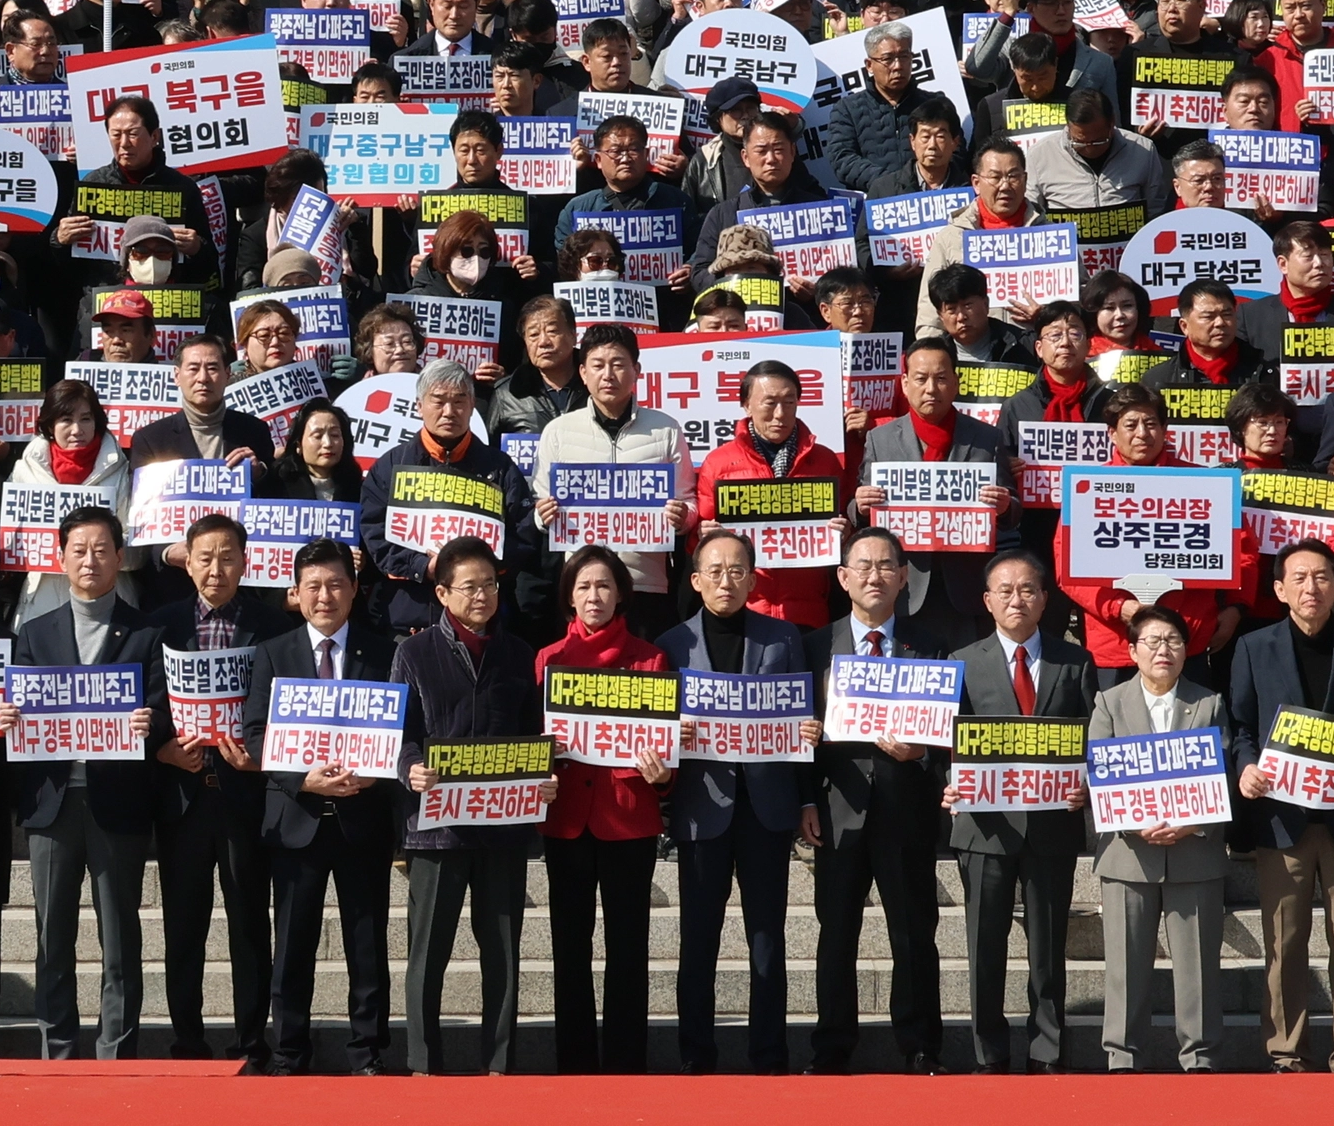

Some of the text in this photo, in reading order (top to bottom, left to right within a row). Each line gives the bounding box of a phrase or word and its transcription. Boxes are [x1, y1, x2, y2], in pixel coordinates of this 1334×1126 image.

[725, 30, 787, 53] 국민의힘
[164, 60, 195, 71] 국민의힘
[685, 54, 727, 79] 대구
[733, 56, 798, 86] 중남구
[166, 71, 266, 113] 북구을
[327, 112, 379, 125] 국민의힘
[308, 134, 451, 158] 대구중구남구
[968, 227, 1072, 263] 광주전남 다퍼주고
[1181, 232, 1247, 250] 국민의힘
[1141, 259, 1262, 286] 대구 달성군
[717, 351, 750, 361] 국민의힘
[1094, 482, 1135, 493] 국민의힘
[1094, 497, 1212, 520] 보수의심장
[1094, 522, 1210, 549] 상주문경
[1144, 553, 1223, 569] 당원협의회
[549, 672, 678, 712] 대구경북행정통합특별법
[685, 678, 806, 715] 광주전남 다퍼주고
[276, 684, 399, 729] 광주전남 다퍼주고
[956, 722, 1081, 757] 대구경북행정통합특별법
